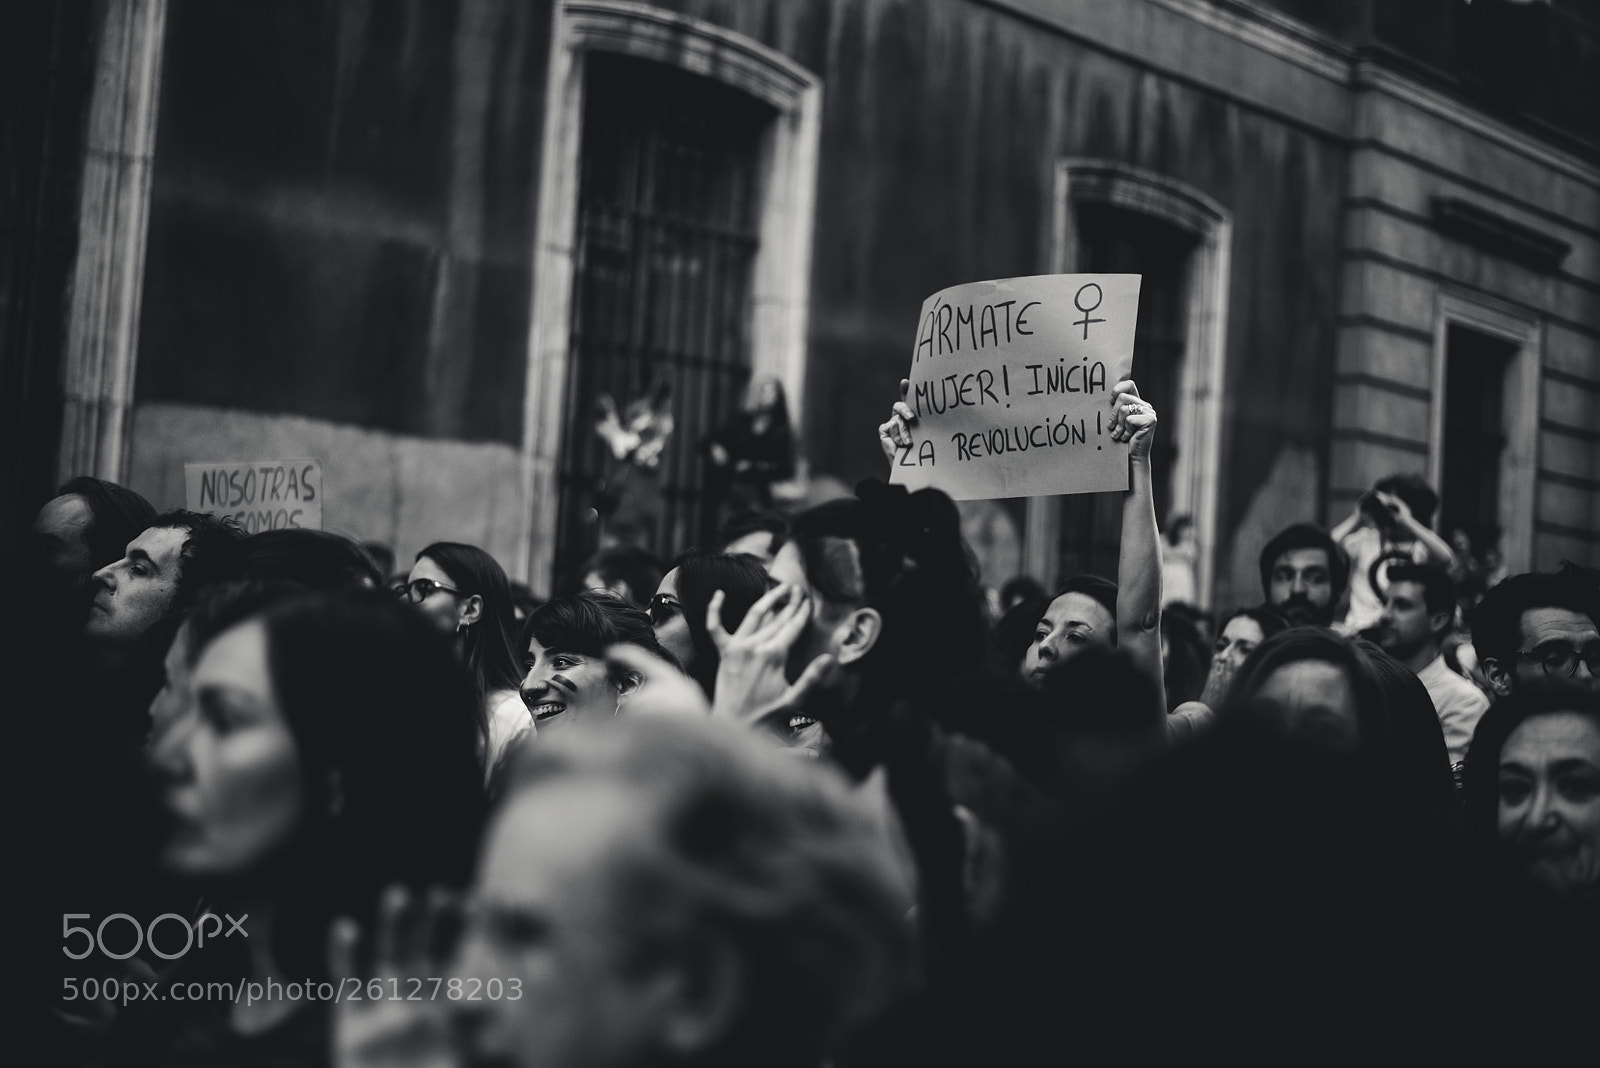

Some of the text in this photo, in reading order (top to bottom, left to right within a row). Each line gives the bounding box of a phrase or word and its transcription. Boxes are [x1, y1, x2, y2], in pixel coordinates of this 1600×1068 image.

[916, 296, 1042, 363] ÁRMATE
[914, 364, 1011, 418] MUJER!
[200, 465, 315, 508] NOSOTRAS
